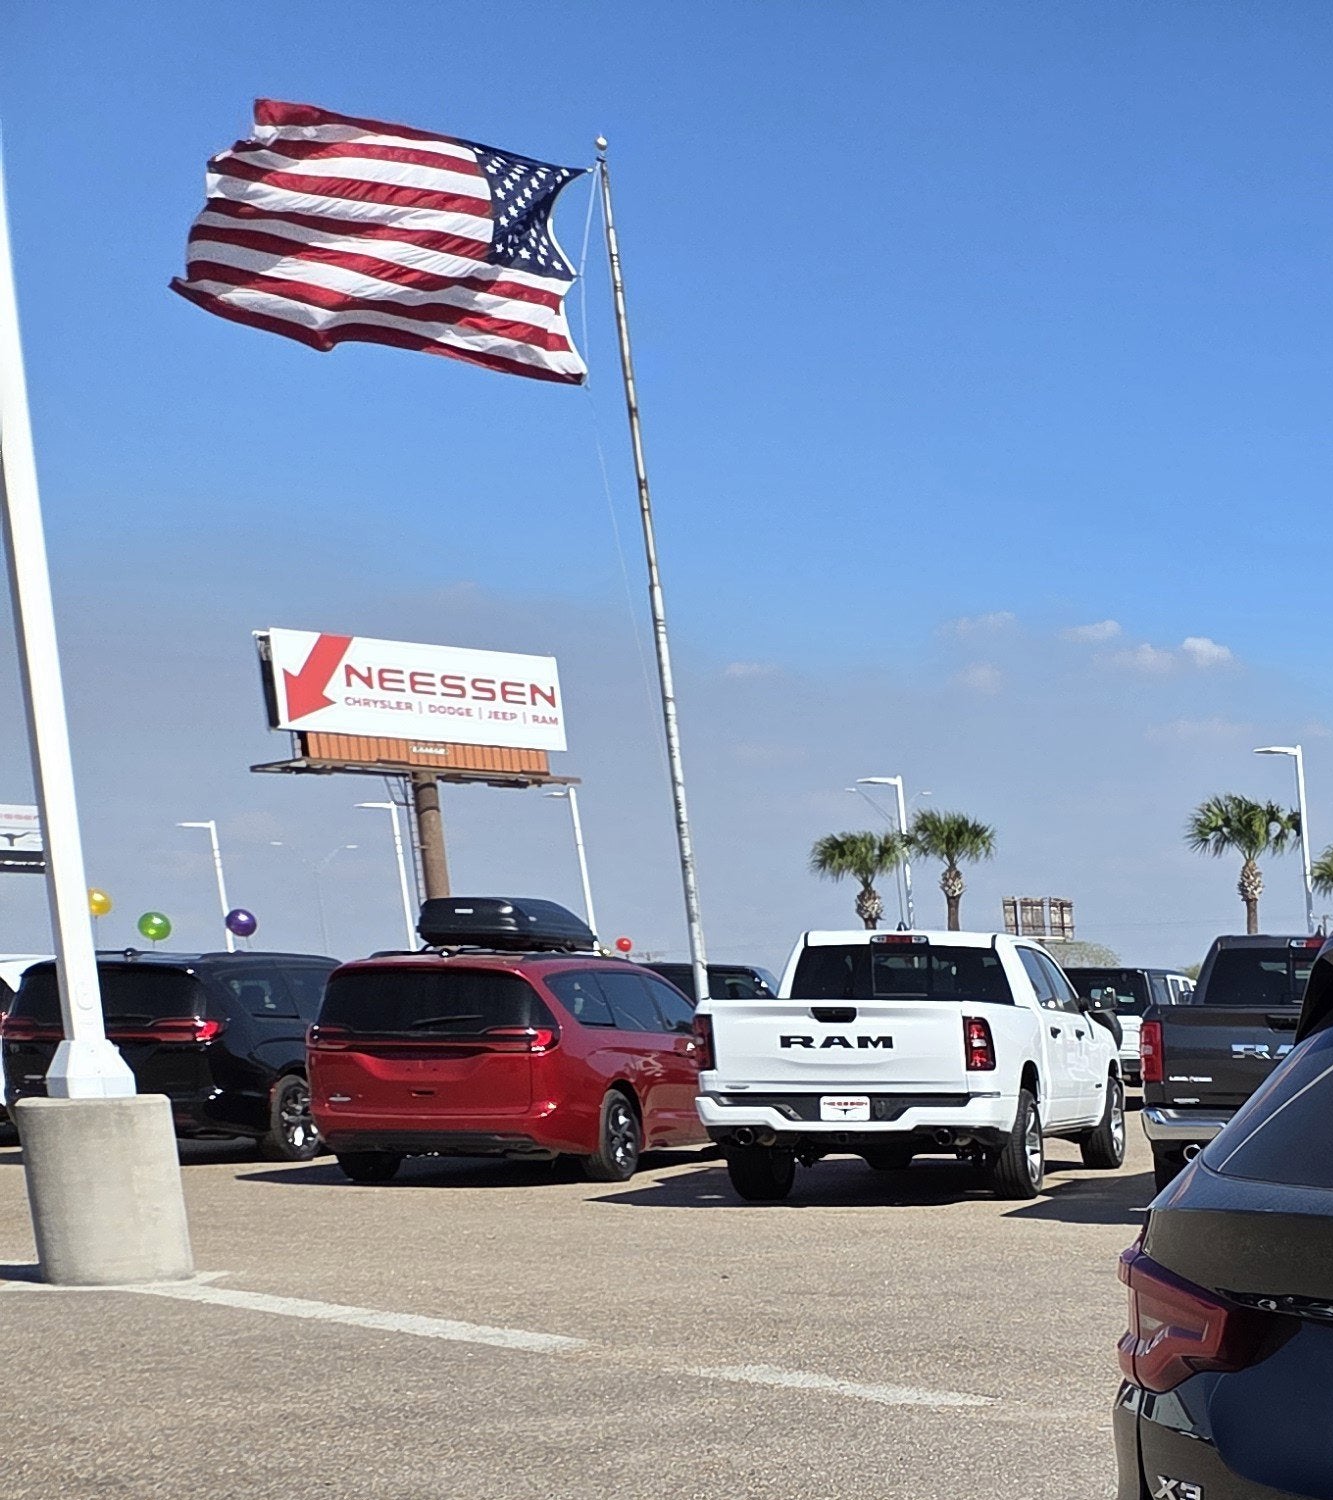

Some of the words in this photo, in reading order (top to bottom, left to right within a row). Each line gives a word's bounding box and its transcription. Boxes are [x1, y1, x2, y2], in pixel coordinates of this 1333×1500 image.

[344, 663, 557, 708] NEESSEN
[344, 696, 414, 712] CHRYSLER
[428, 704, 474, 718] DODGE
[487, 710, 518, 721] JEEP
[532, 714, 559, 726] RAM
[779, 1035, 894, 1049] RAM
